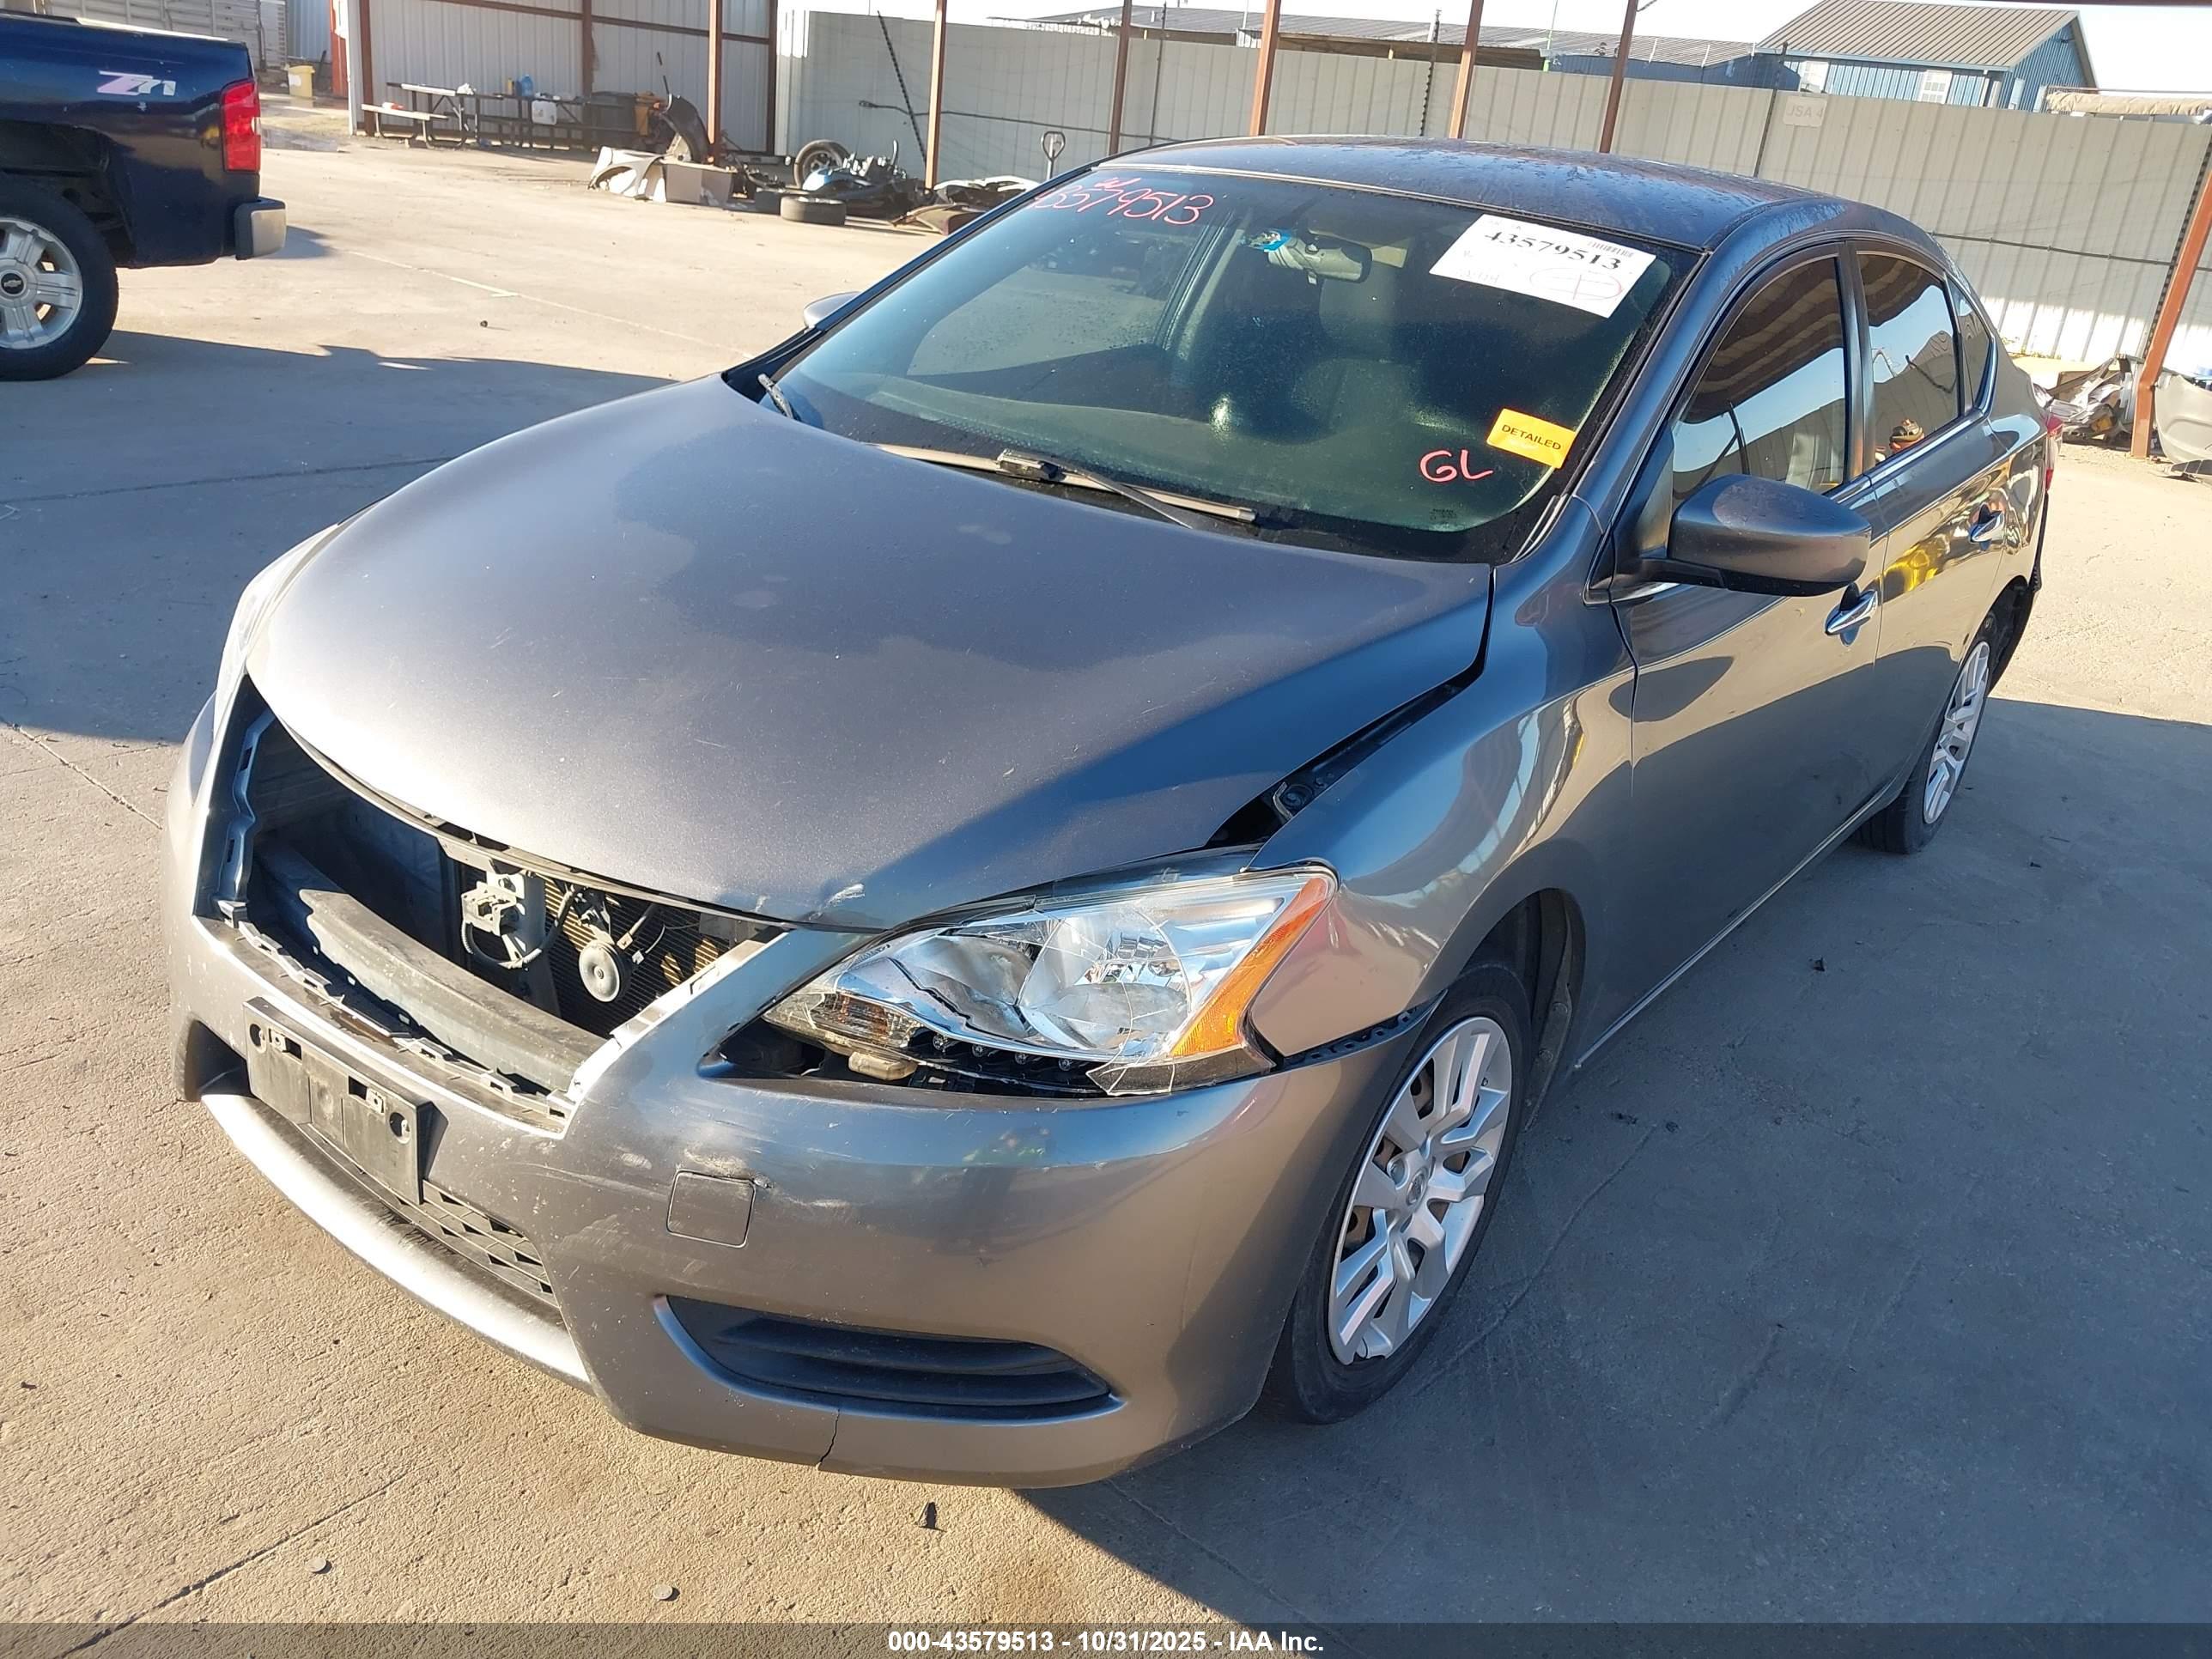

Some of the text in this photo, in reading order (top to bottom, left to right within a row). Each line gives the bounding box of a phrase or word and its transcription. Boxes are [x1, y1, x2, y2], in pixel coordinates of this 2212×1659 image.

[97, 70, 176, 95] Z71
[1484, 230, 1622, 270] 43579513
[1501, 423, 1562, 451] DETAILED
[1419, 448, 1494, 483] GL
